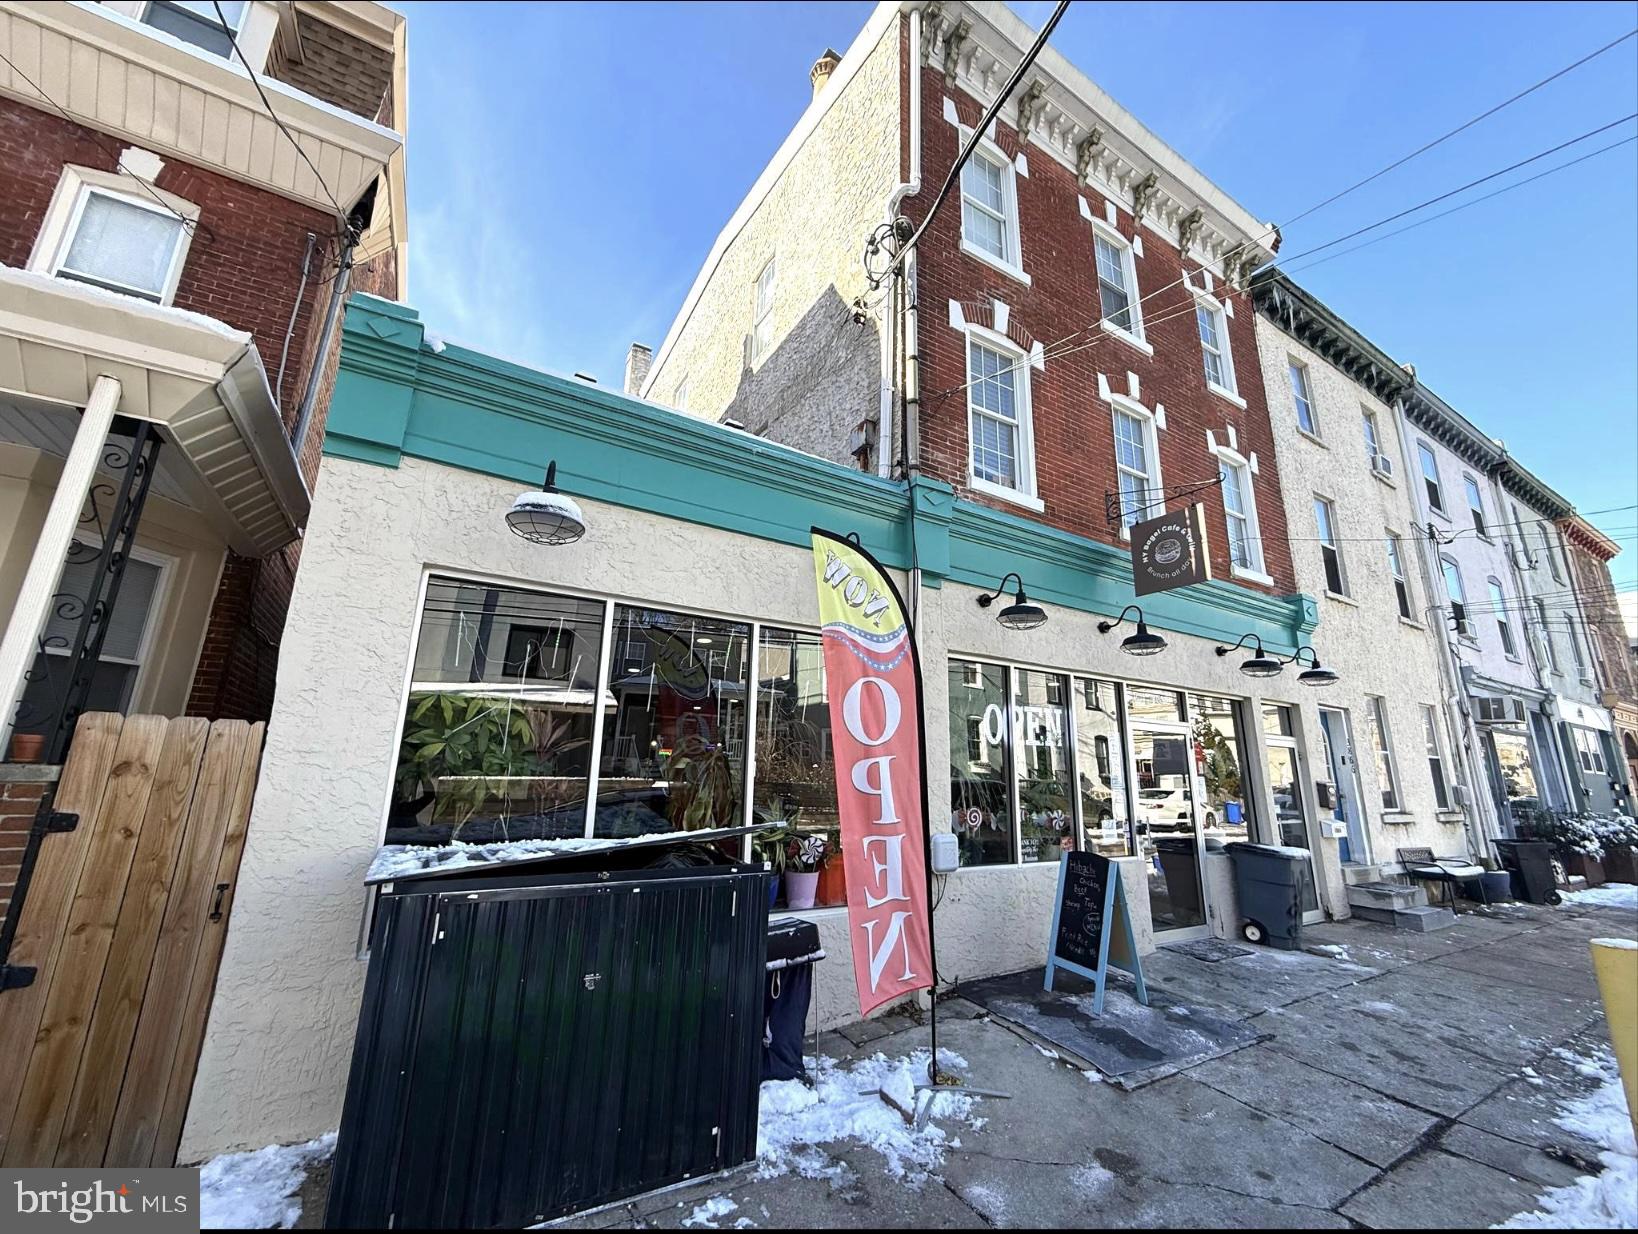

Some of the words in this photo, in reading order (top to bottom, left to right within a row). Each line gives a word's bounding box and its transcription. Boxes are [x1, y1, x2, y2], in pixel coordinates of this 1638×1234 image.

[1144, 529, 1161, 550] Bagel
[1162, 524, 1181, 532] Cafe
[1147, 566, 1170, 578] Brunch
[983, 703, 1063, 747] OPEN
